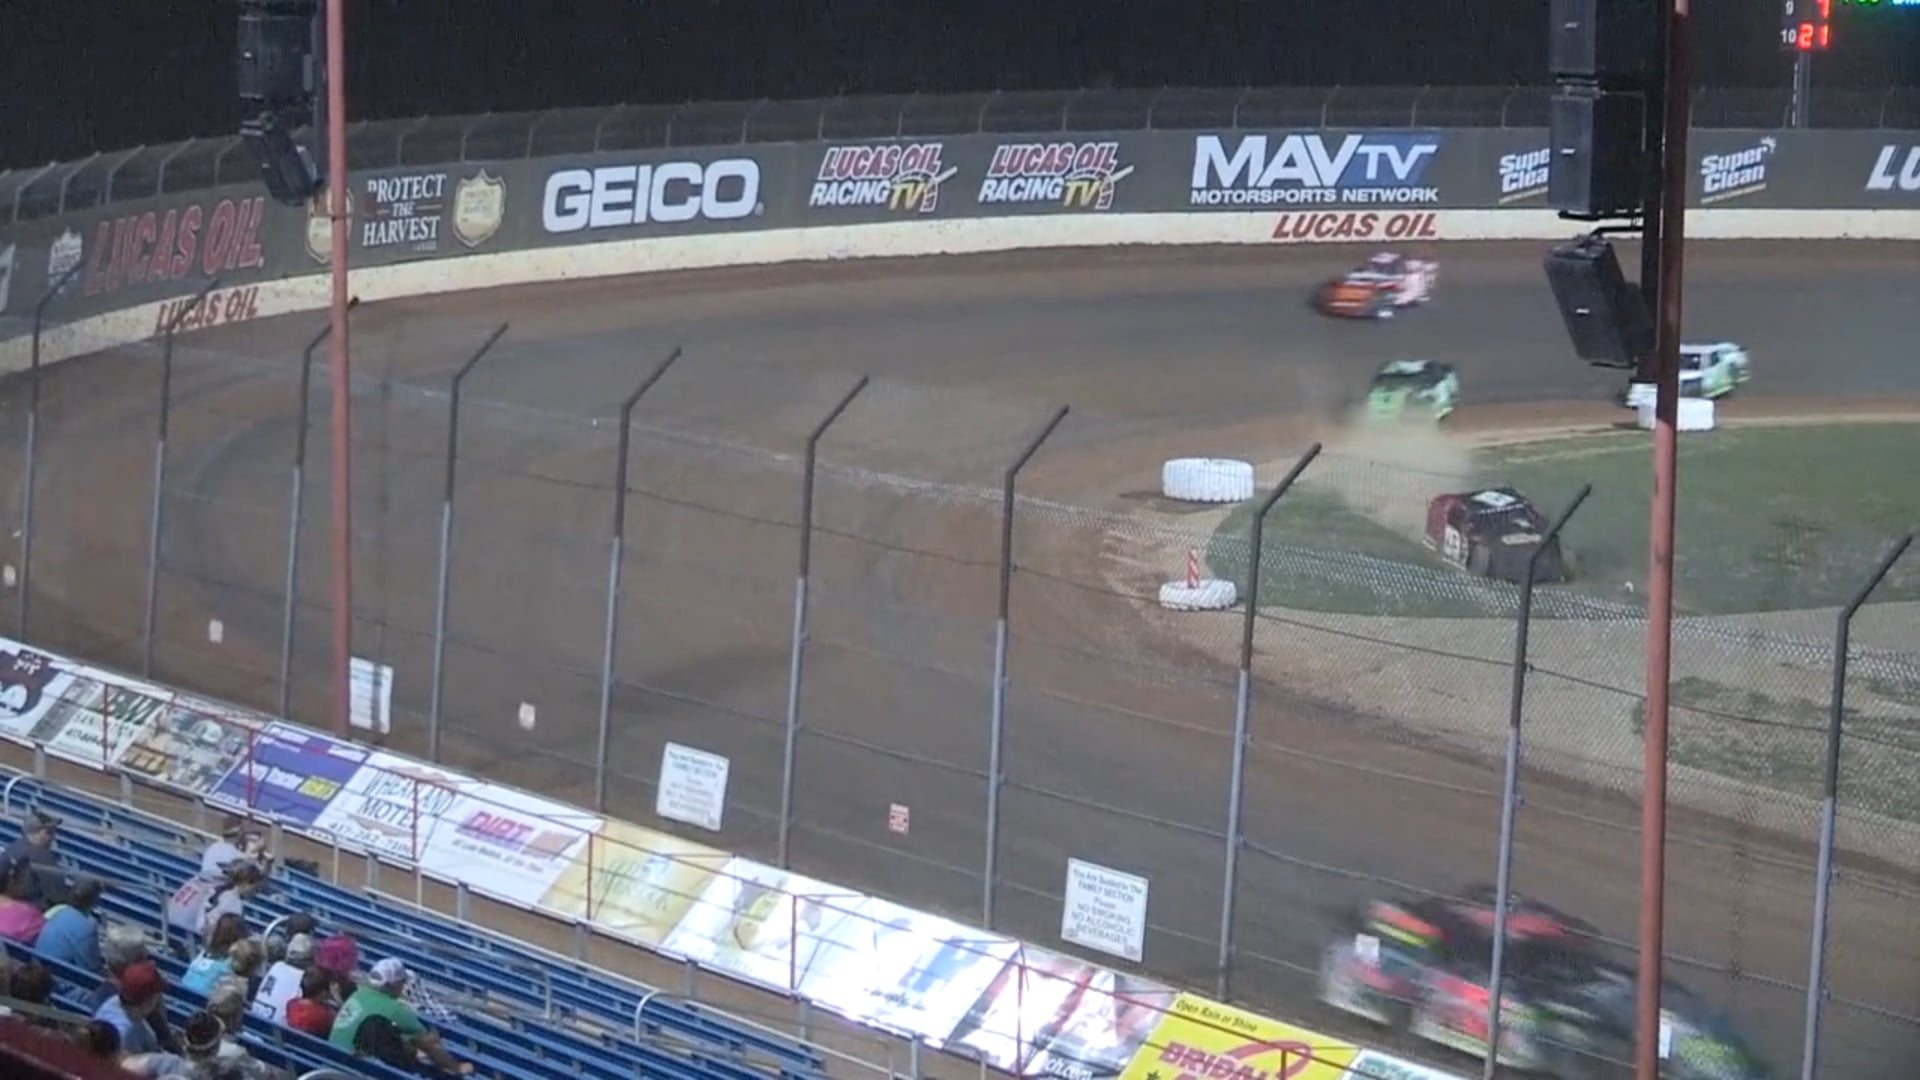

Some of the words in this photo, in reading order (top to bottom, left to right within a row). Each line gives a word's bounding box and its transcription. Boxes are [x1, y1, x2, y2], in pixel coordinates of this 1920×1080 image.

[1780, 28, 1797, 43] 10
[1798, 23, 1829, 49] 21
[819, 146, 901, 180] LUCAS
[900, 143, 943, 177] OIL
[987, 145, 1075, 177] LUCAS
[1072, 142, 1119, 175] OIL
[1192, 134, 1438, 188] MAVTV
[1500, 148, 1549, 176] Supe
[1701, 145, 1768, 174] Super
[978, 177, 1065, 202] RACING
[1501, 167, 1548, 193] Clea
[1703, 163, 1765, 193] Clean
[542, 158, 760, 233] GEICO
[809, 179, 891, 207] RACING
[1191, 188, 1337, 204] MOTORSPORTS
[1342, 187, 1438, 203] NETWORK
[392, 203, 415, 217] THE
[362, 216, 441, 247] HARVEST
[1272, 213, 1378, 239] LUCAS
[1384, 213, 1438, 237] OIL
[84, 205, 202, 296] LUCAS
[202, 197, 264, 275] OIL
[155, 295, 222, 335] LUCAS
[224, 286, 260, 318] OIL
